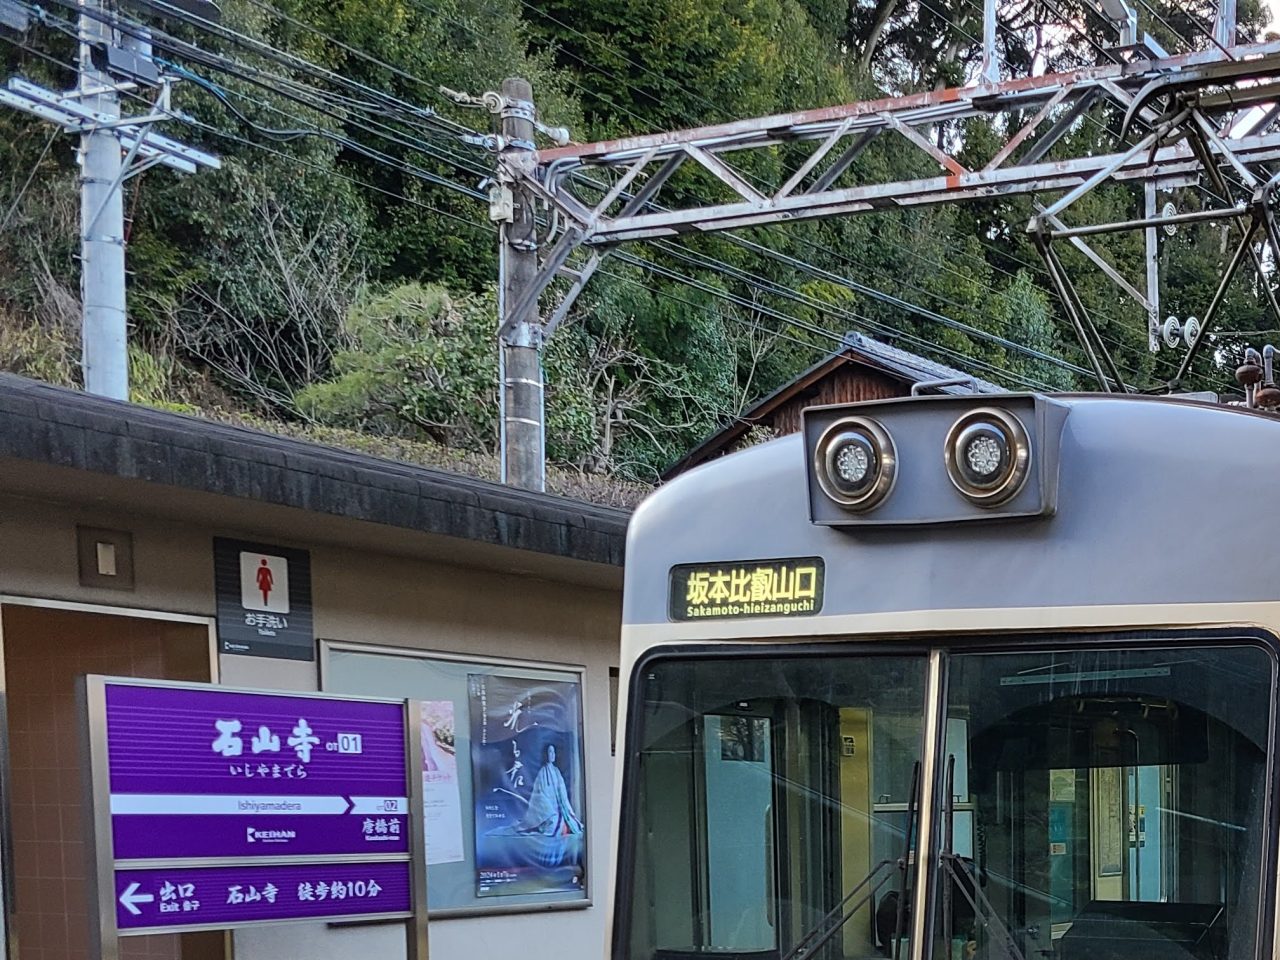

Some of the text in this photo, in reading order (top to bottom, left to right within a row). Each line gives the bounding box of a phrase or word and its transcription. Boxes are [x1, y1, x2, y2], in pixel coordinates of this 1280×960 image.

[686, 566, 817, 605] 坂本比叡山口
[686, 599, 814, 617] Sakamoto-hieizanguchi
[245, 613, 288, 629] お手洗い
[212, 719, 320, 762] 石山寺
[229, 763, 307, 779] いしやまでら
[238, 801, 301, 812] Ishiyamadera
[160, 879, 383, 904] 出口 石山寺 徒歩約10分
[160, 902, 180, 912] Exit
